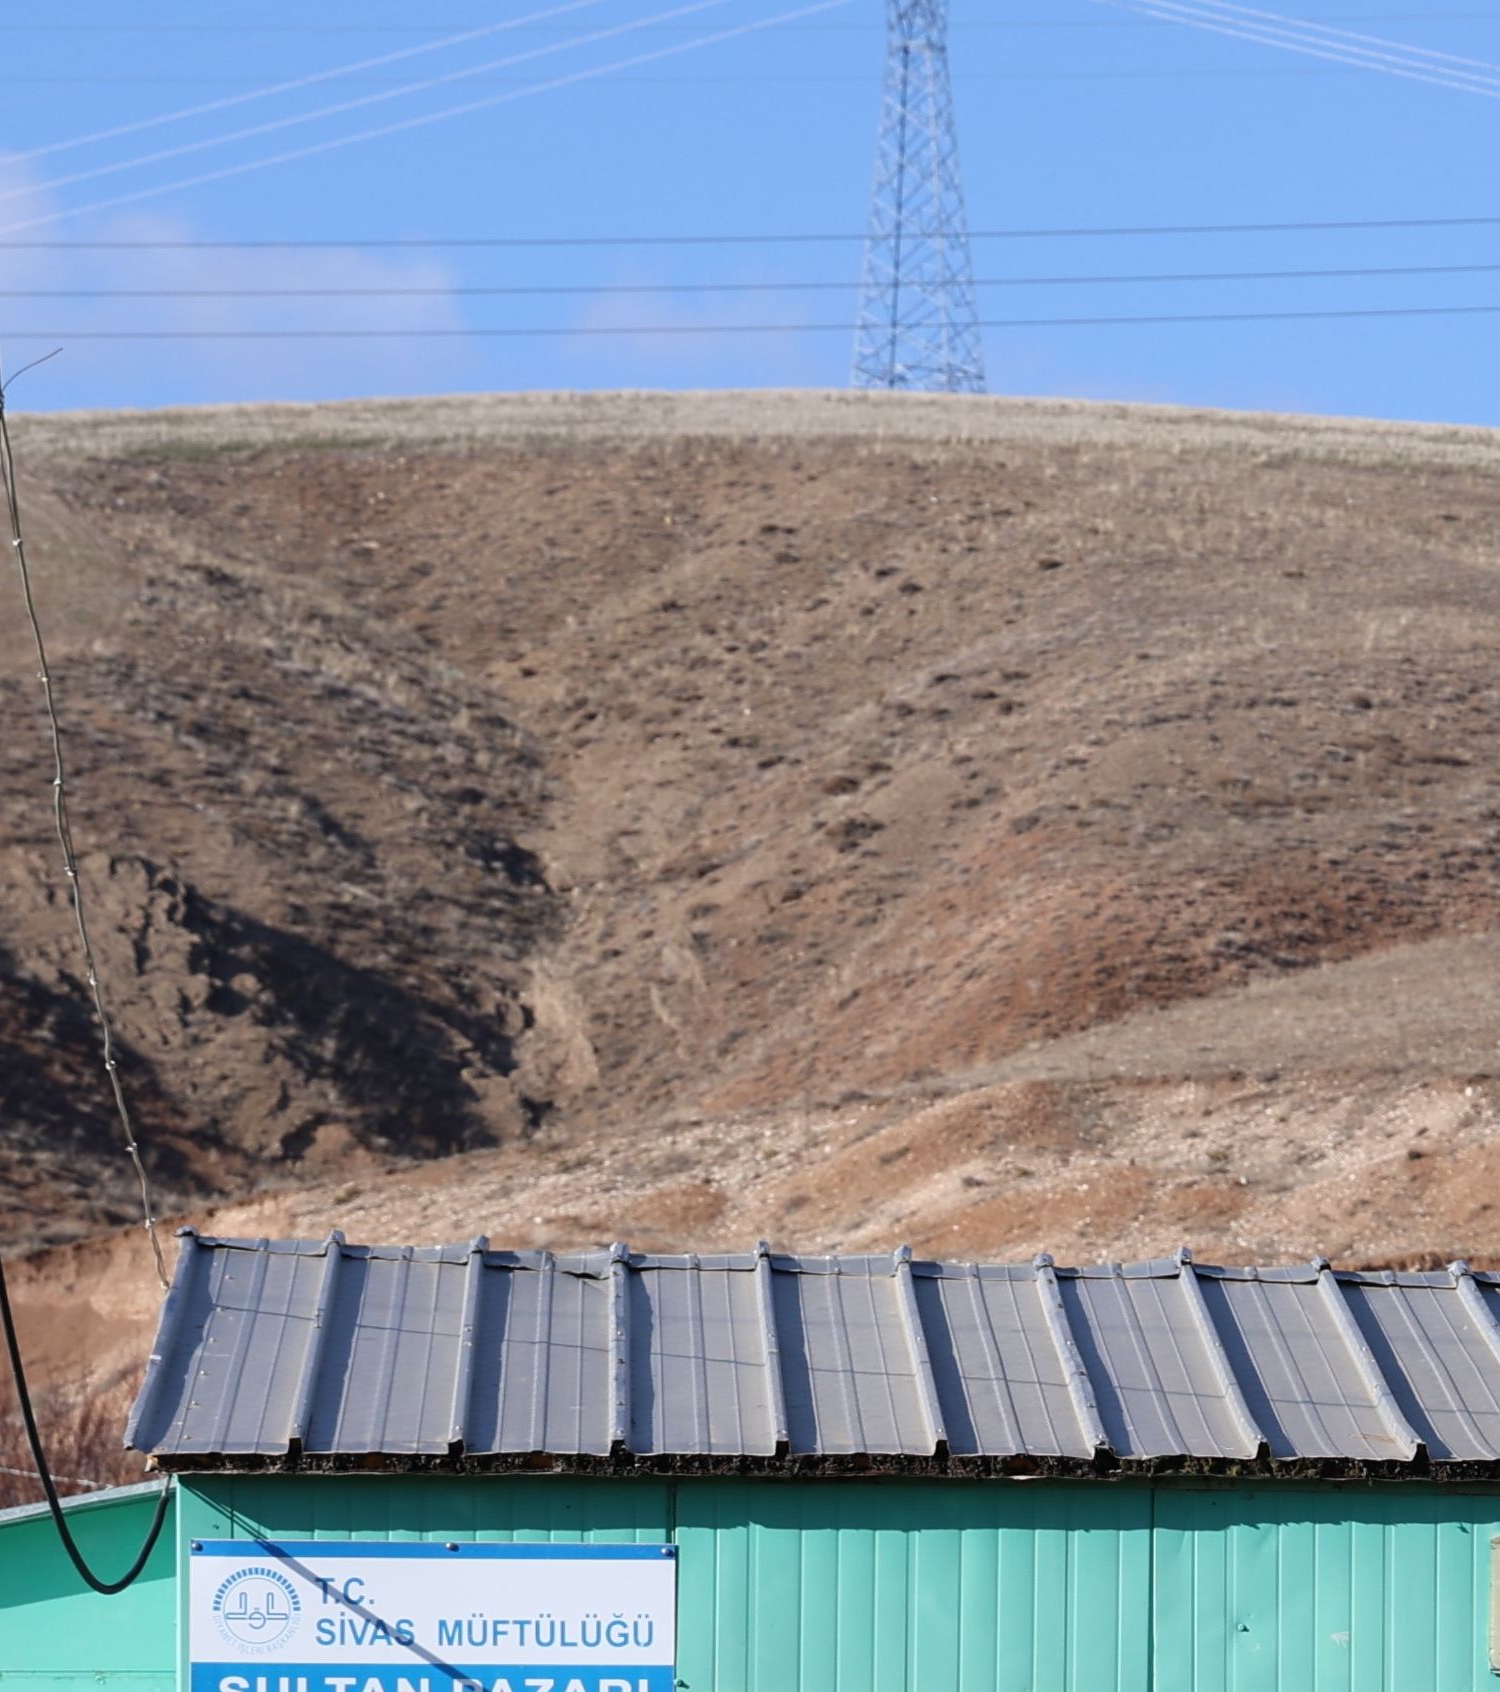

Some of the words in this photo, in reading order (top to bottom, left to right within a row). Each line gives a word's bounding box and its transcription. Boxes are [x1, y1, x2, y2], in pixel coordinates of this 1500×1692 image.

[315, 1576, 375, 1605] T.C.
[316, 1612, 415, 1647] SİVAS
[438, 1613, 654, 1649] MÜFTÜLÜĞÜ
